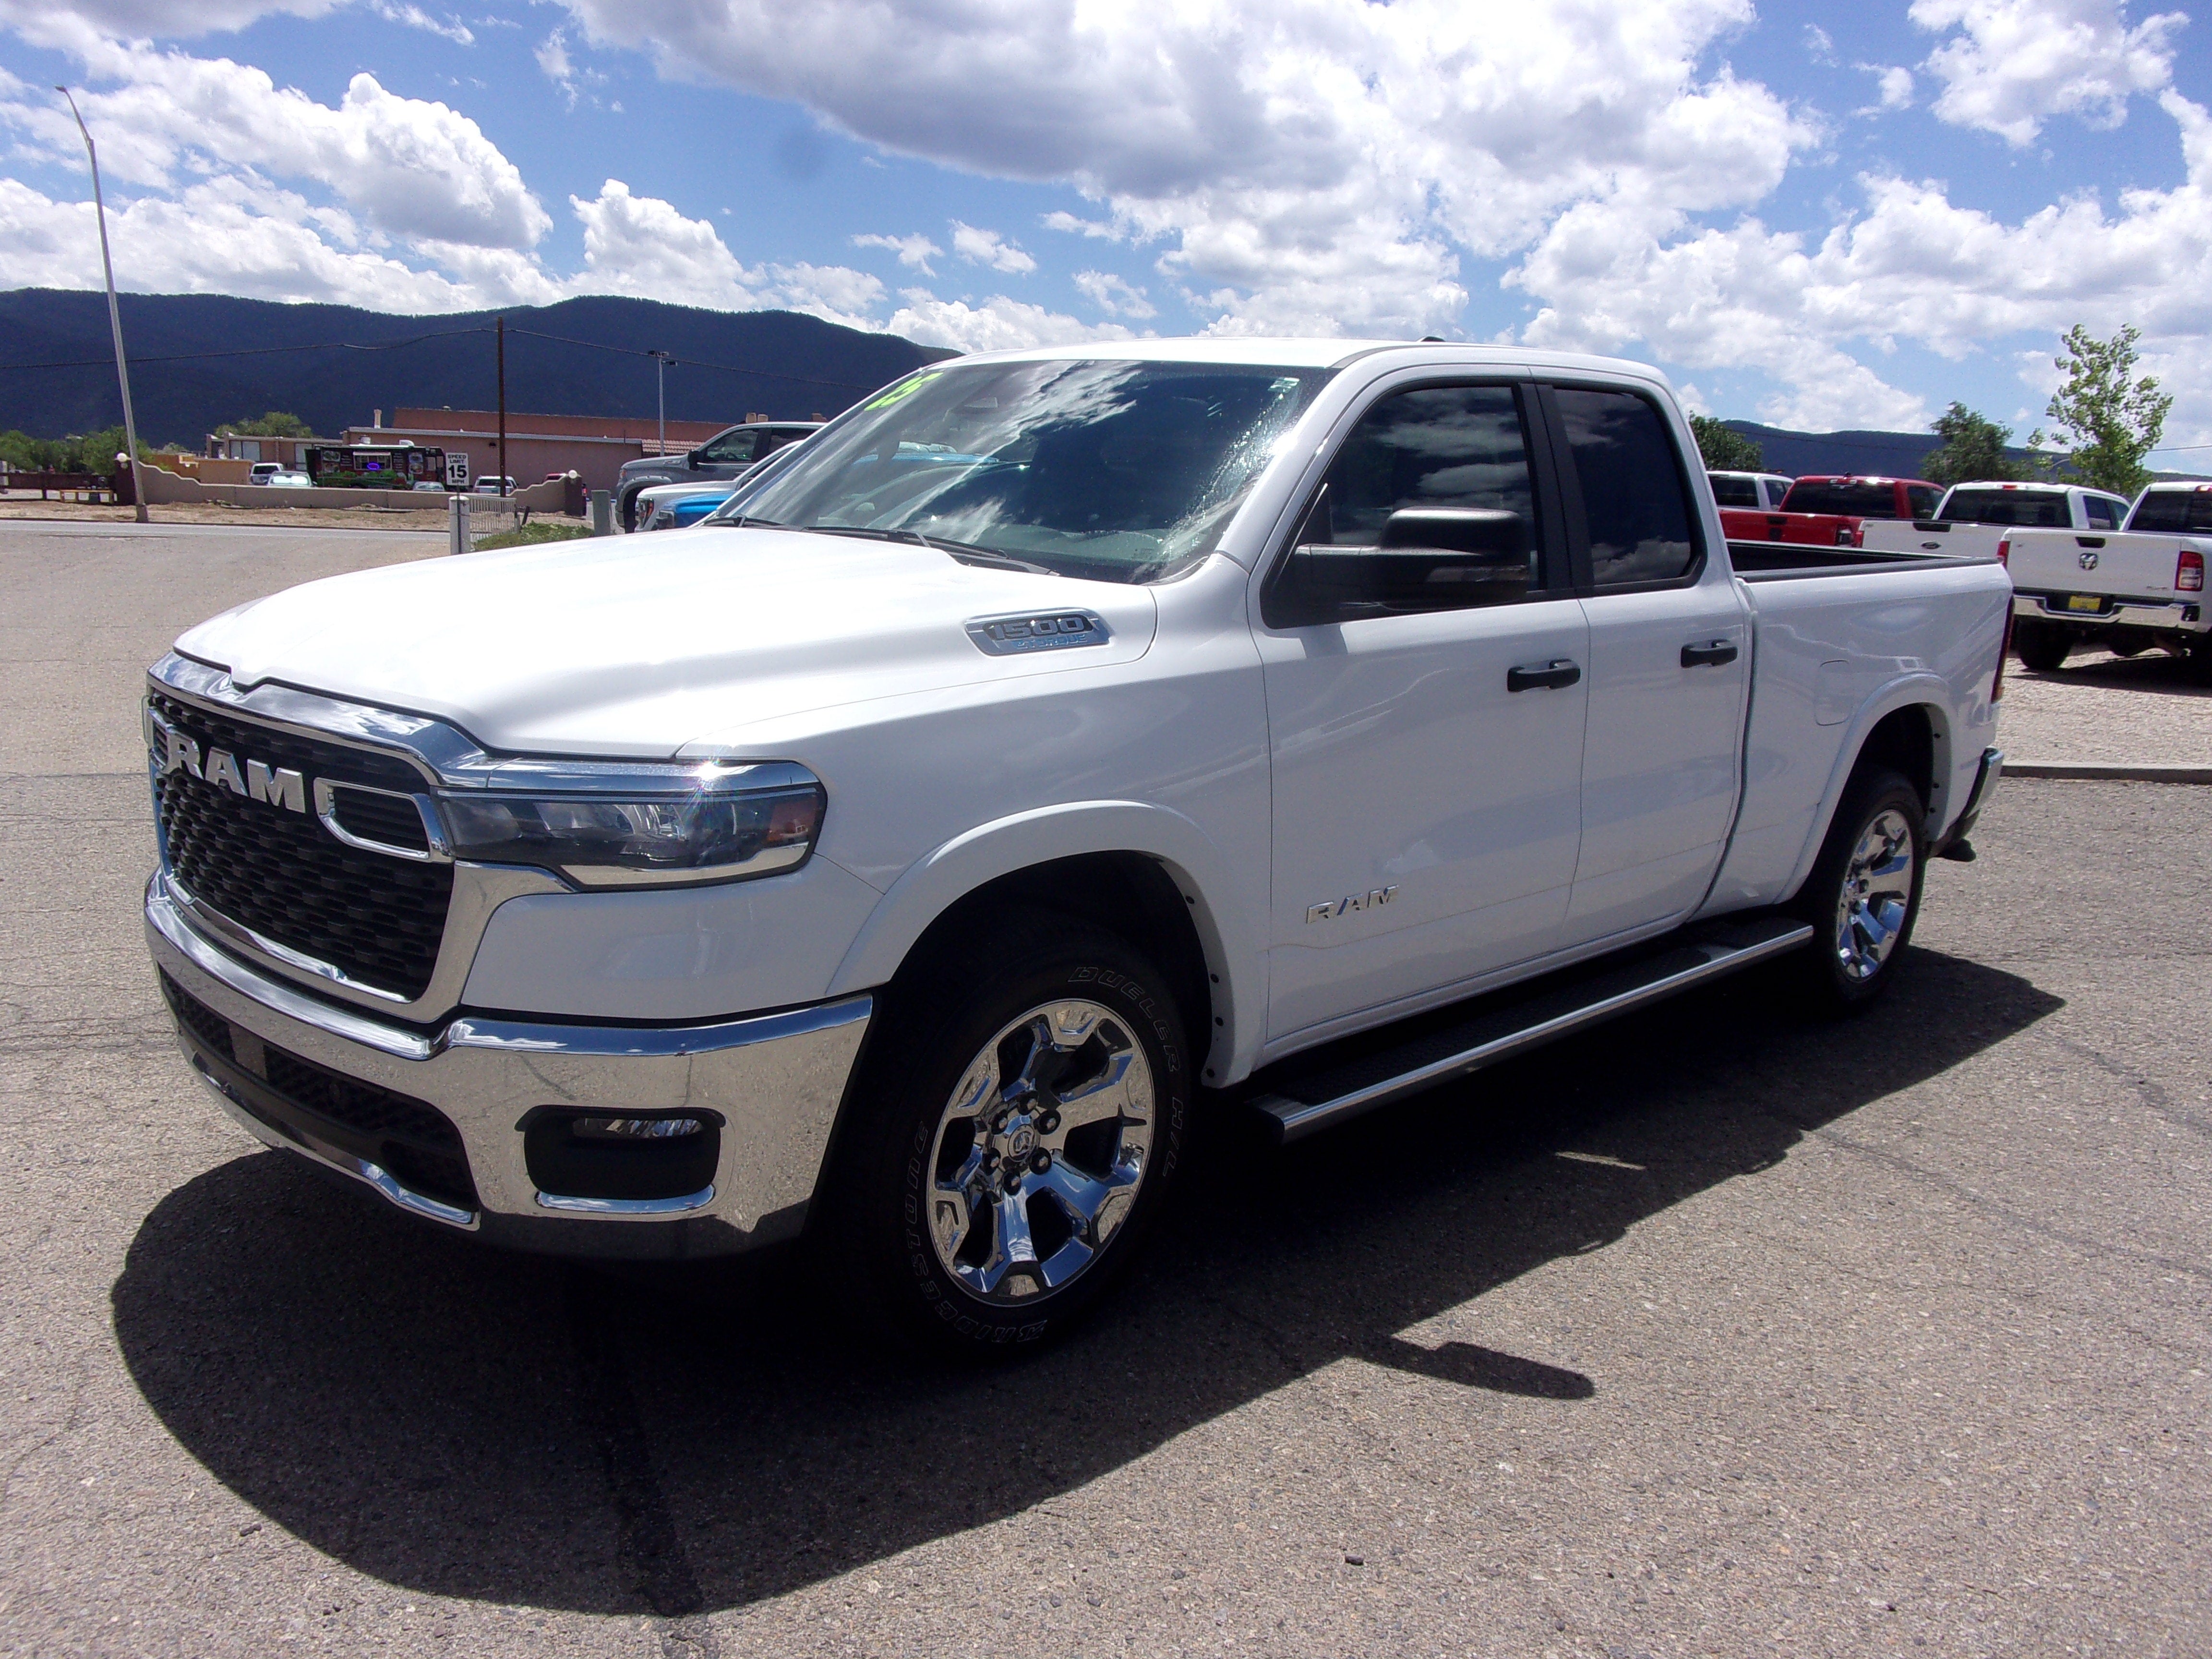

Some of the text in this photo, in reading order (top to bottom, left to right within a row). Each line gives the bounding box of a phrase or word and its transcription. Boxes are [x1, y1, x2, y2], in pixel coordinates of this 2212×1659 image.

[448, 465, 467, 478] 15
[989, 617, 1084, 640] 1500
[162, 728, 306, 814] RAM
[1306, 884, 1399, 924] RAM
[1068, 966, 1181, 1073] DUELER
[904, 1120, 1048, 1344] BRIDGESTONE
